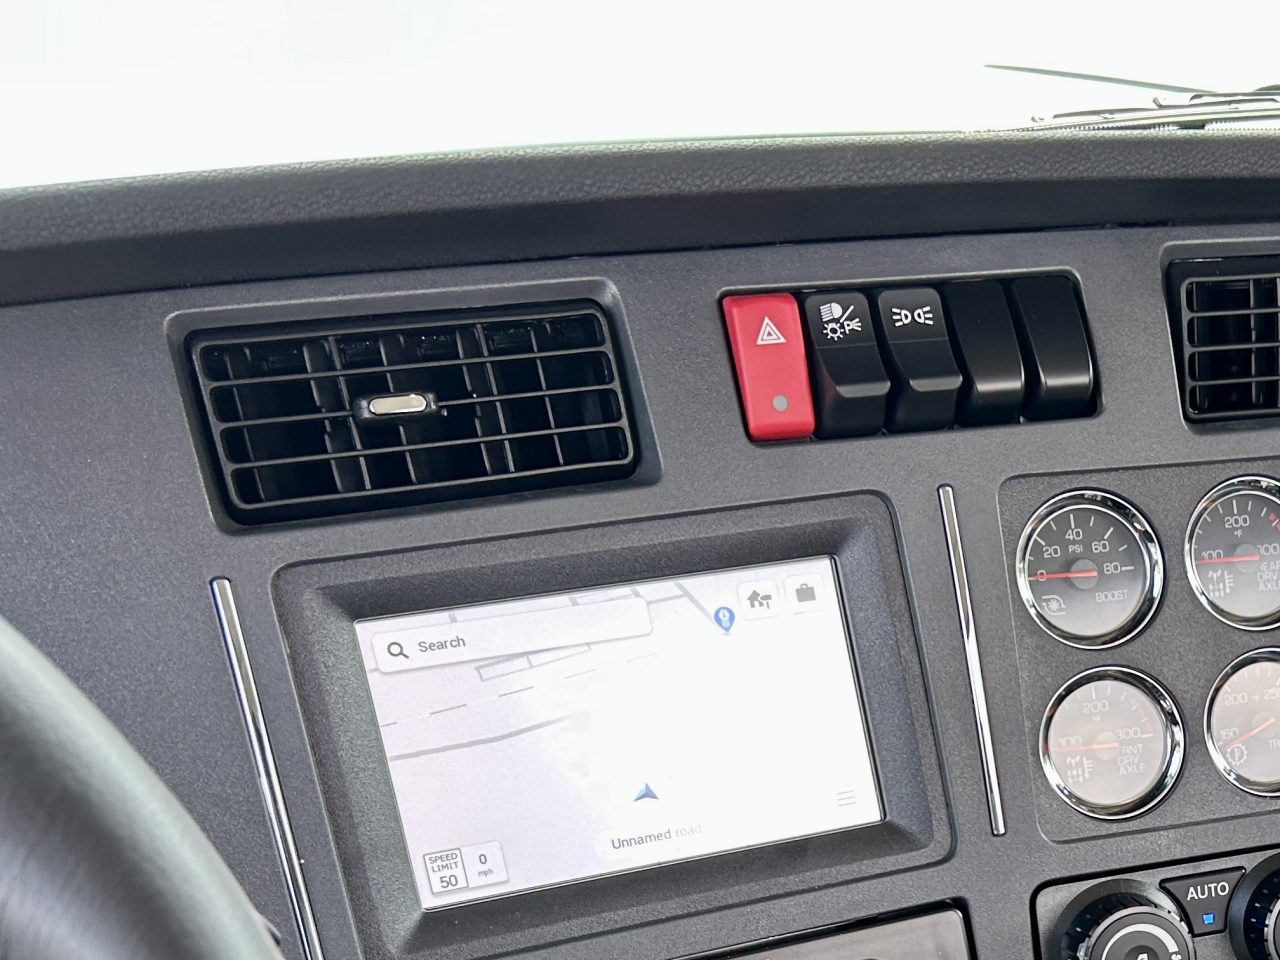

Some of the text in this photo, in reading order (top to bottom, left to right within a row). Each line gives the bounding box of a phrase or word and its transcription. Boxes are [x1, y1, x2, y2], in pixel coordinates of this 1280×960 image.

[1225, 515, 1249, 528] 200
[1065, 528, 1082, 540] 40
[1043, 541, 1109, 558] 20 PSI 60
[1104, 562, 1120, 574] 80
[1257, 572, 1278, 582] DRV
[1096, 590, 1128, 602] BOOST
[417, 636, 466, 653] Search
[1224, 692, 1247, 705] 200
[1083, 700, 1109, 714] 200
[1221, 728, 1239, 739] 150
[1117, 755, 1139, 765] DRV
[1120, 763, 1146, 774] AXLE
[611, 824, 702, 850] Unnamed road
[428, 852, 458, 865] SPEED
[478, 853, 488, 865] 0
[431, 861, 459, 873] LIMIT
[477, 868, 494, 878] mph
[439, 874, 459, 889] 50
[1186, 881, 1230, 901] AUTO
